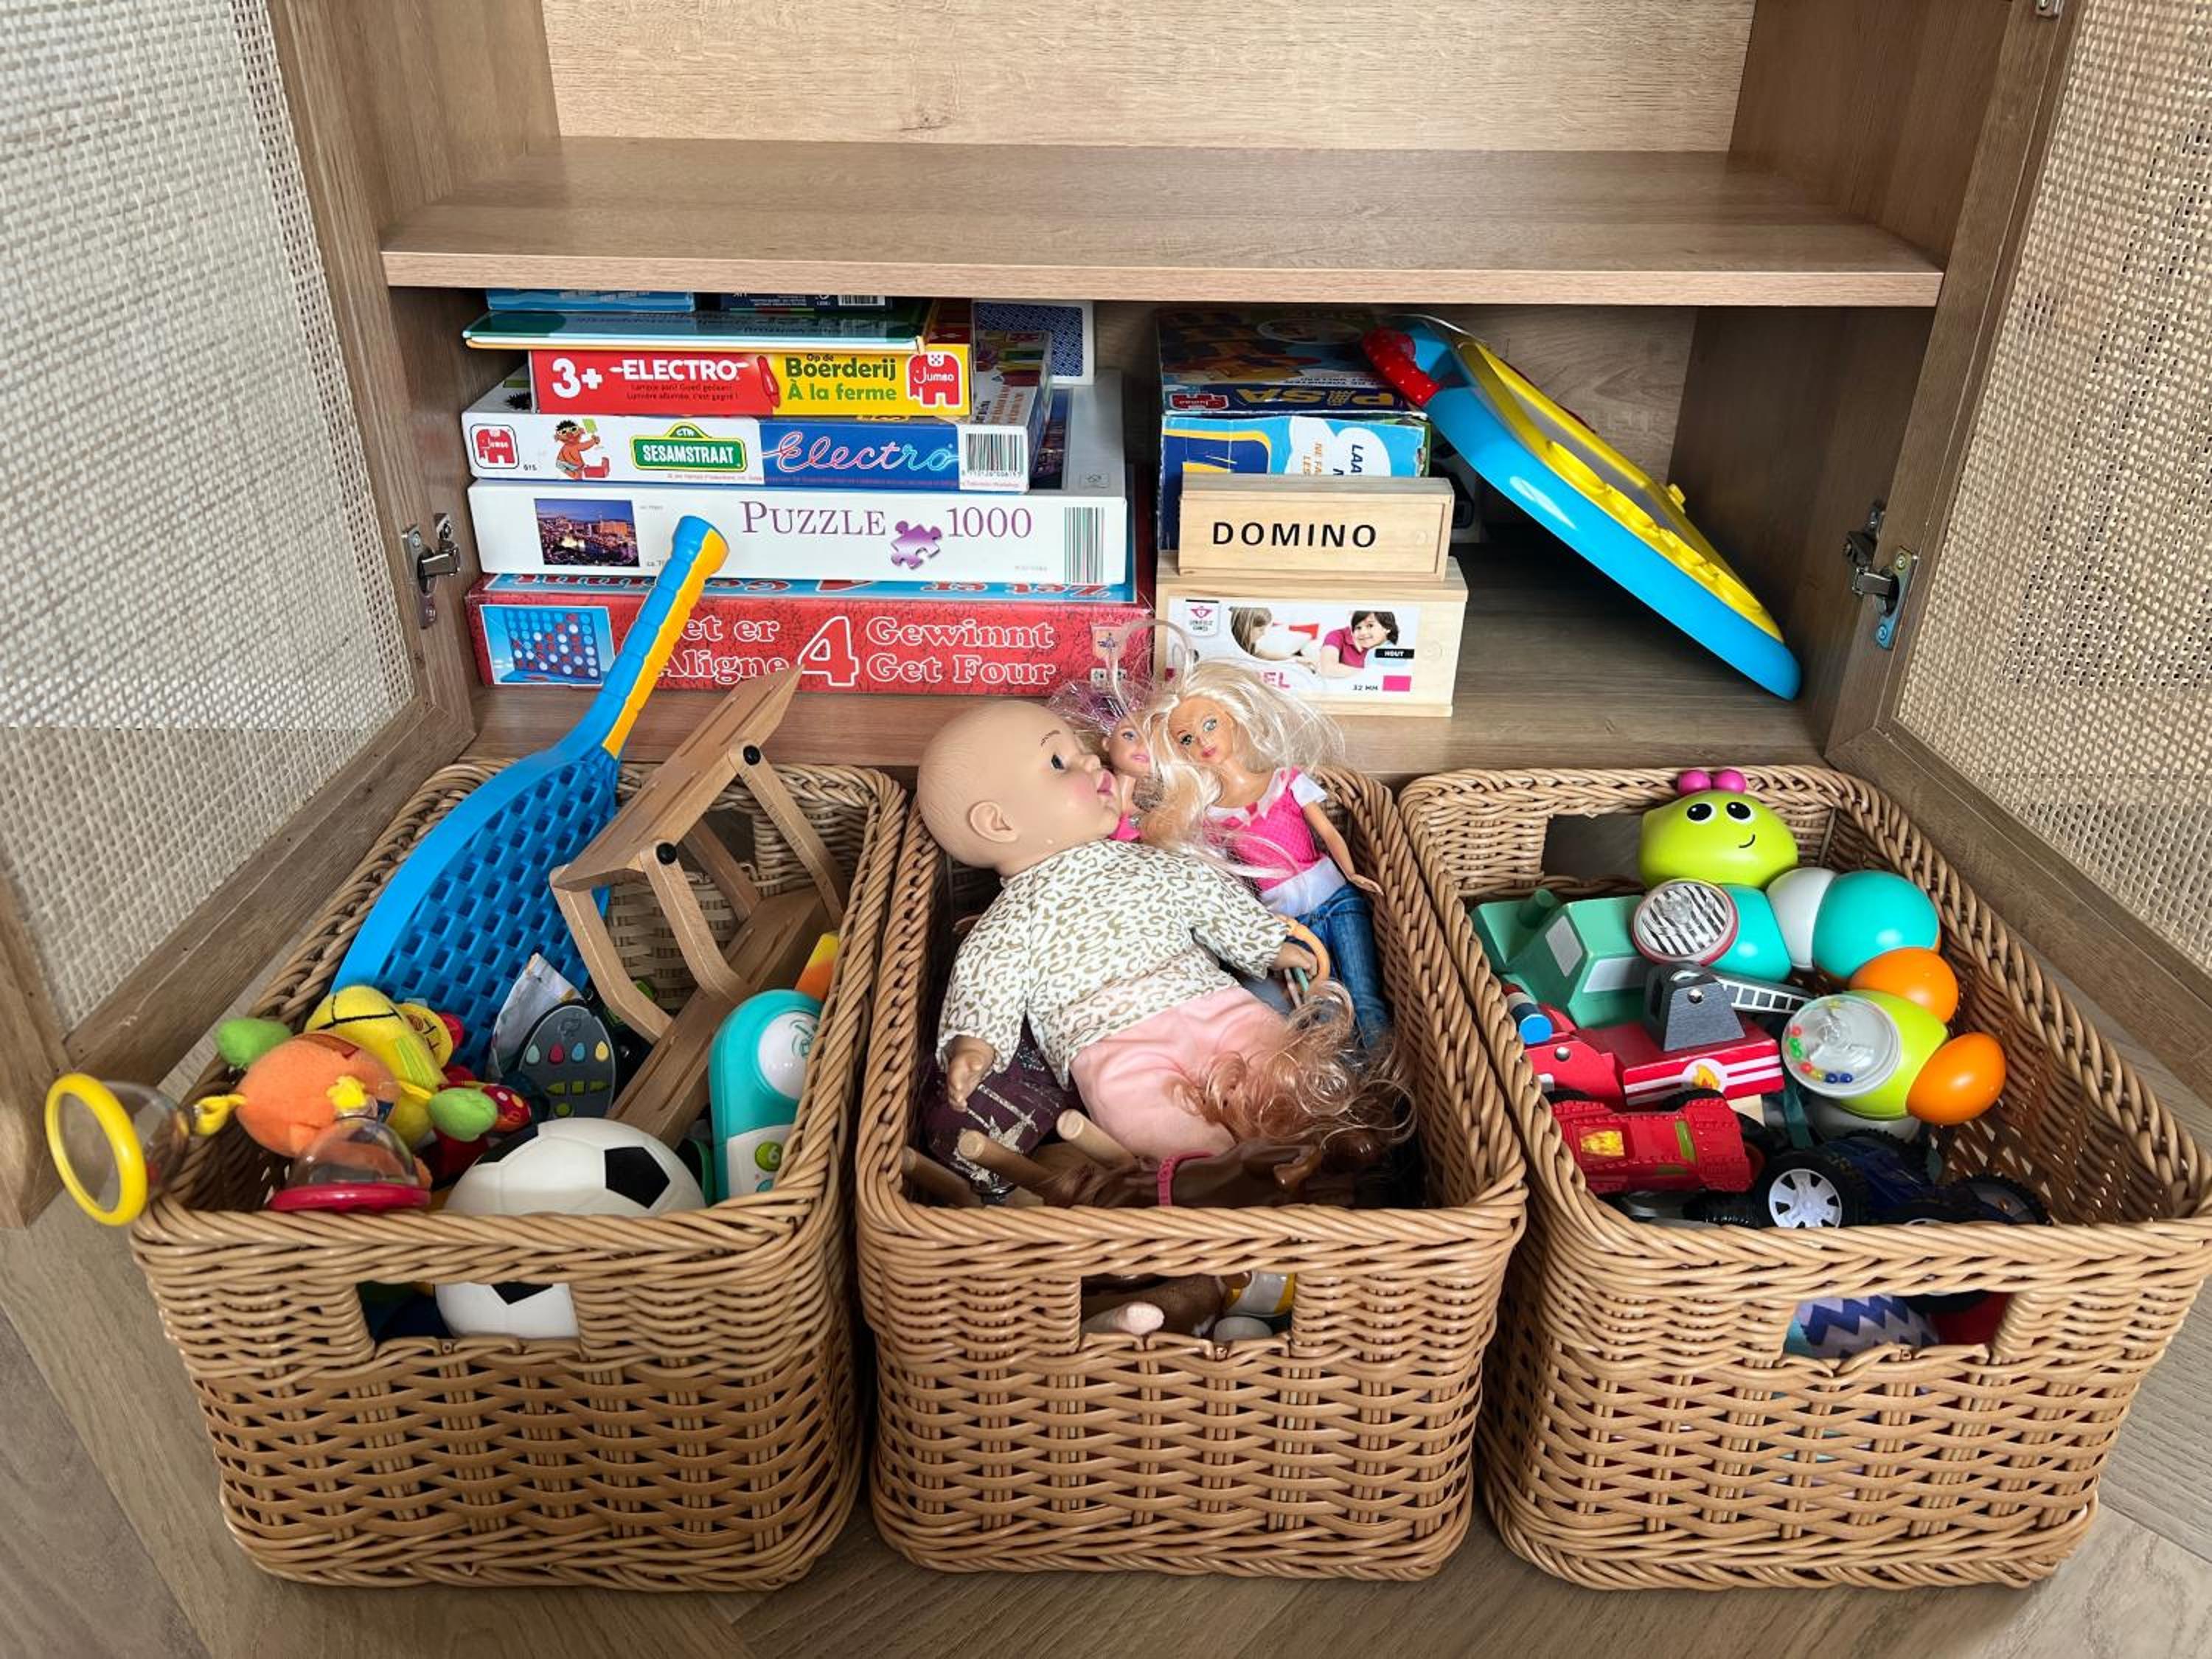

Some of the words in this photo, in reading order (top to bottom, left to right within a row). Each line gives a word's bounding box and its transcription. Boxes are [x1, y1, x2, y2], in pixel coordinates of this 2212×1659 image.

[622, 359, 740, 381] ELECTRO
[785, 357, 897, 380] Boerderij
[807, 354, 821, 362] Op
[552, 358, 603, 399] 3+
[914, 366, 955, 383] Jumbo
[787, 379, 803, 400] À
[810, 383, 829, 400] la
[836, 383, 897, 400] ferme
[676, 427, 695, 437] CTW
[642, 445, 734, 465] SESAMSTRAAT
[776, 431, 952, 473] Electro
[1351, 444, 1364, 473] LAA
[740, 500, 886, 536] PUZZLE
[947, 507, 1033, 538] 1000
[1213, 521, 1377, 548] DOMINO
[681, 615, 723, 641] et
[734, 621, 779, 641] er
[866, 616, 1055, 650] Gewinnt
[798, 616, 860, 686] 4
[866, 653, 943, 685] Get
[953, 654, 1056, 686] Four
